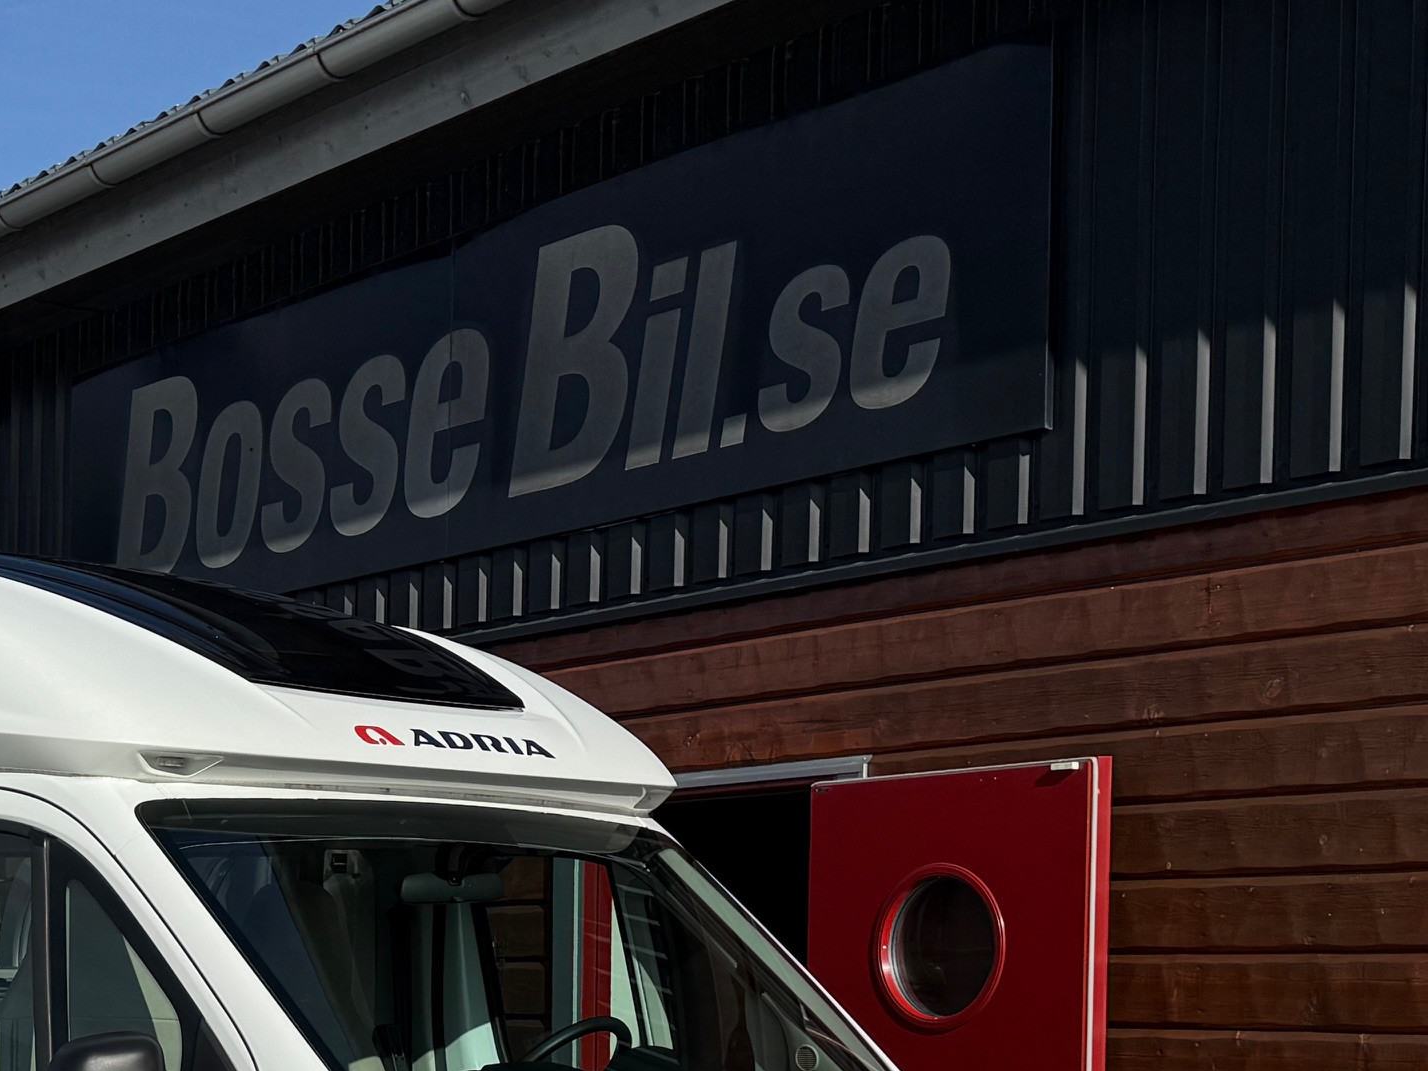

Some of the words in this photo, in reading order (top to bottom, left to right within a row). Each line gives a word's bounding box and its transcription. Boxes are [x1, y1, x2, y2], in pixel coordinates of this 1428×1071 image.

[115, 327, 491, 574] Bosse
[508, 224, 953, 499] Bil.se
[410, 729, 556, 759] ADRIA
